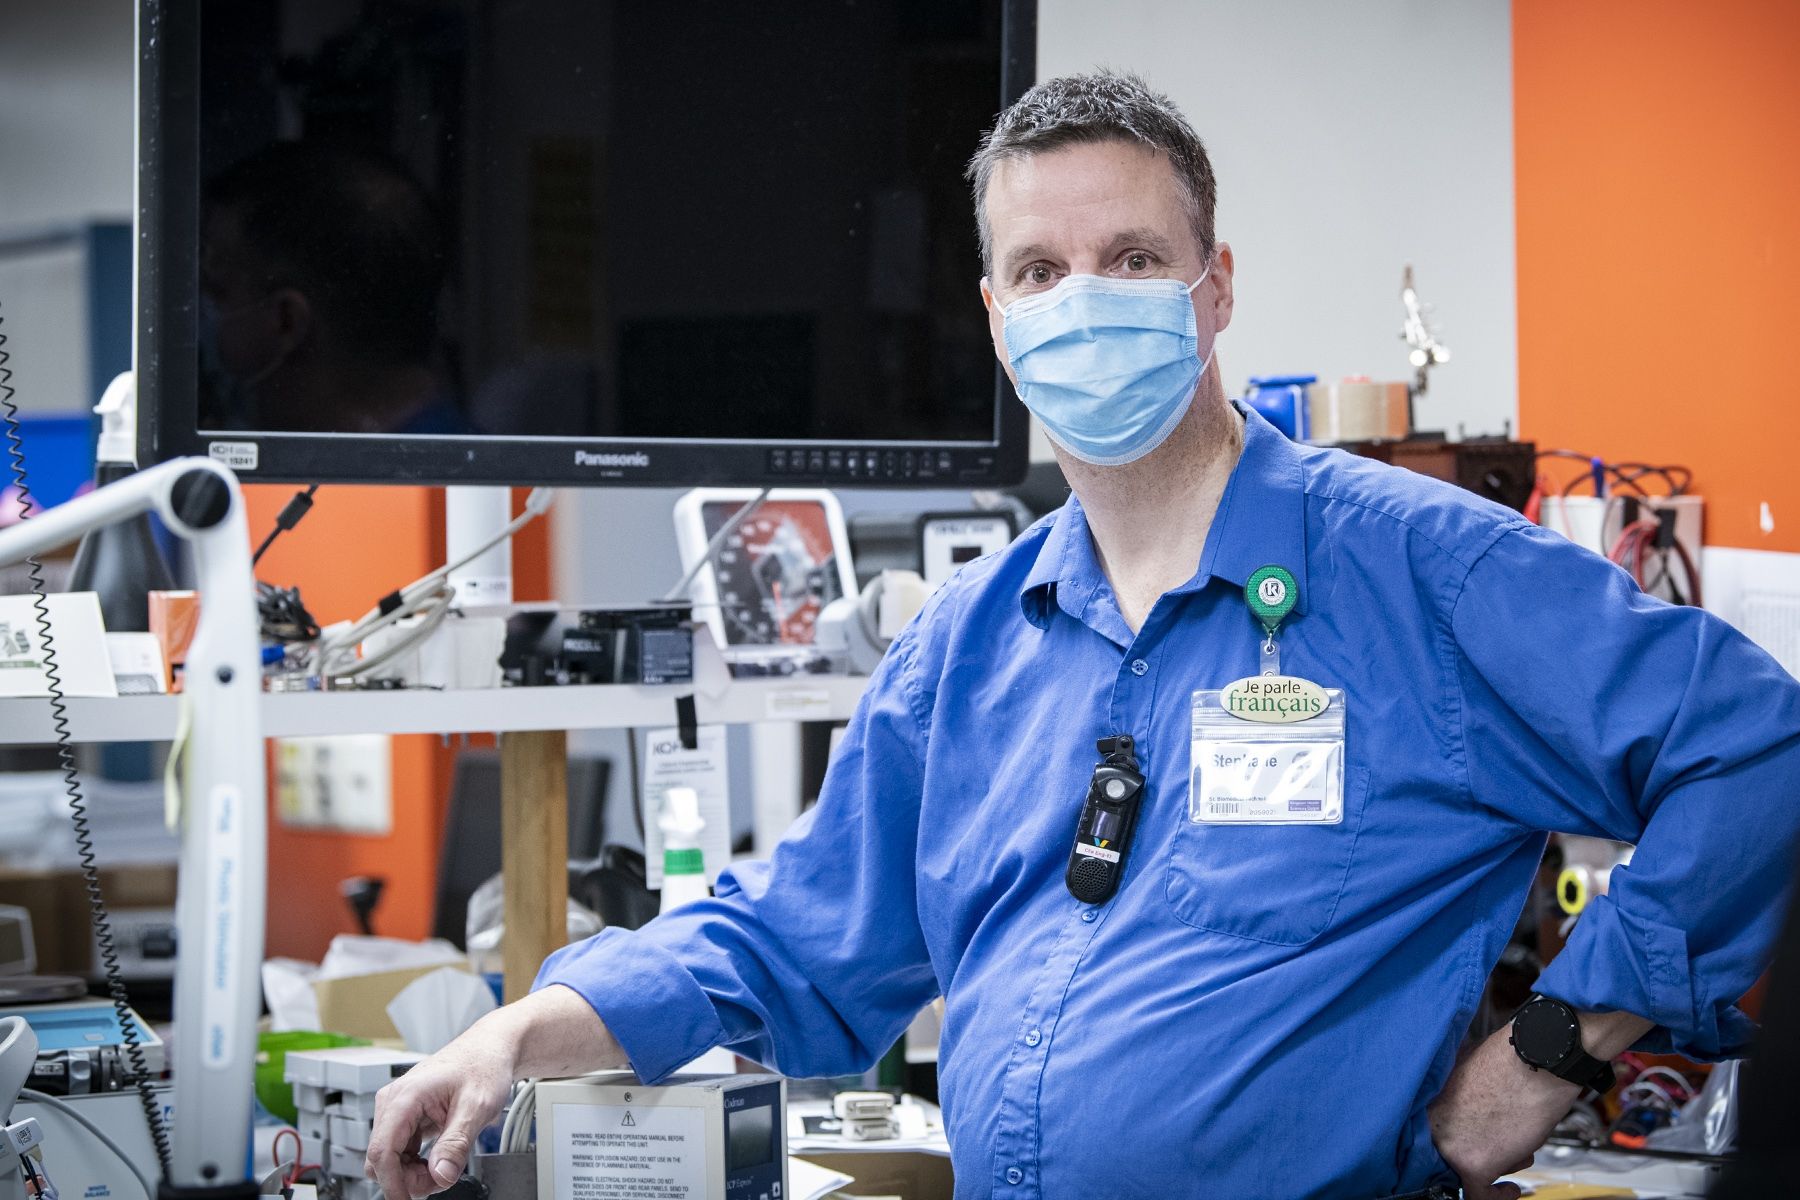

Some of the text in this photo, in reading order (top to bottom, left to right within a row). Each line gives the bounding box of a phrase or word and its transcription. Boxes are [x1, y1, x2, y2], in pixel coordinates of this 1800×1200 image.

[574, 450, 649, 467] Panasonic
[1244, 680, 1301, 696] Je parle
[1229, 689, 1321, 718] français
[724, 1098, 744, 1108] Codman
[84, 1190, 110, 1198] BALANCE
